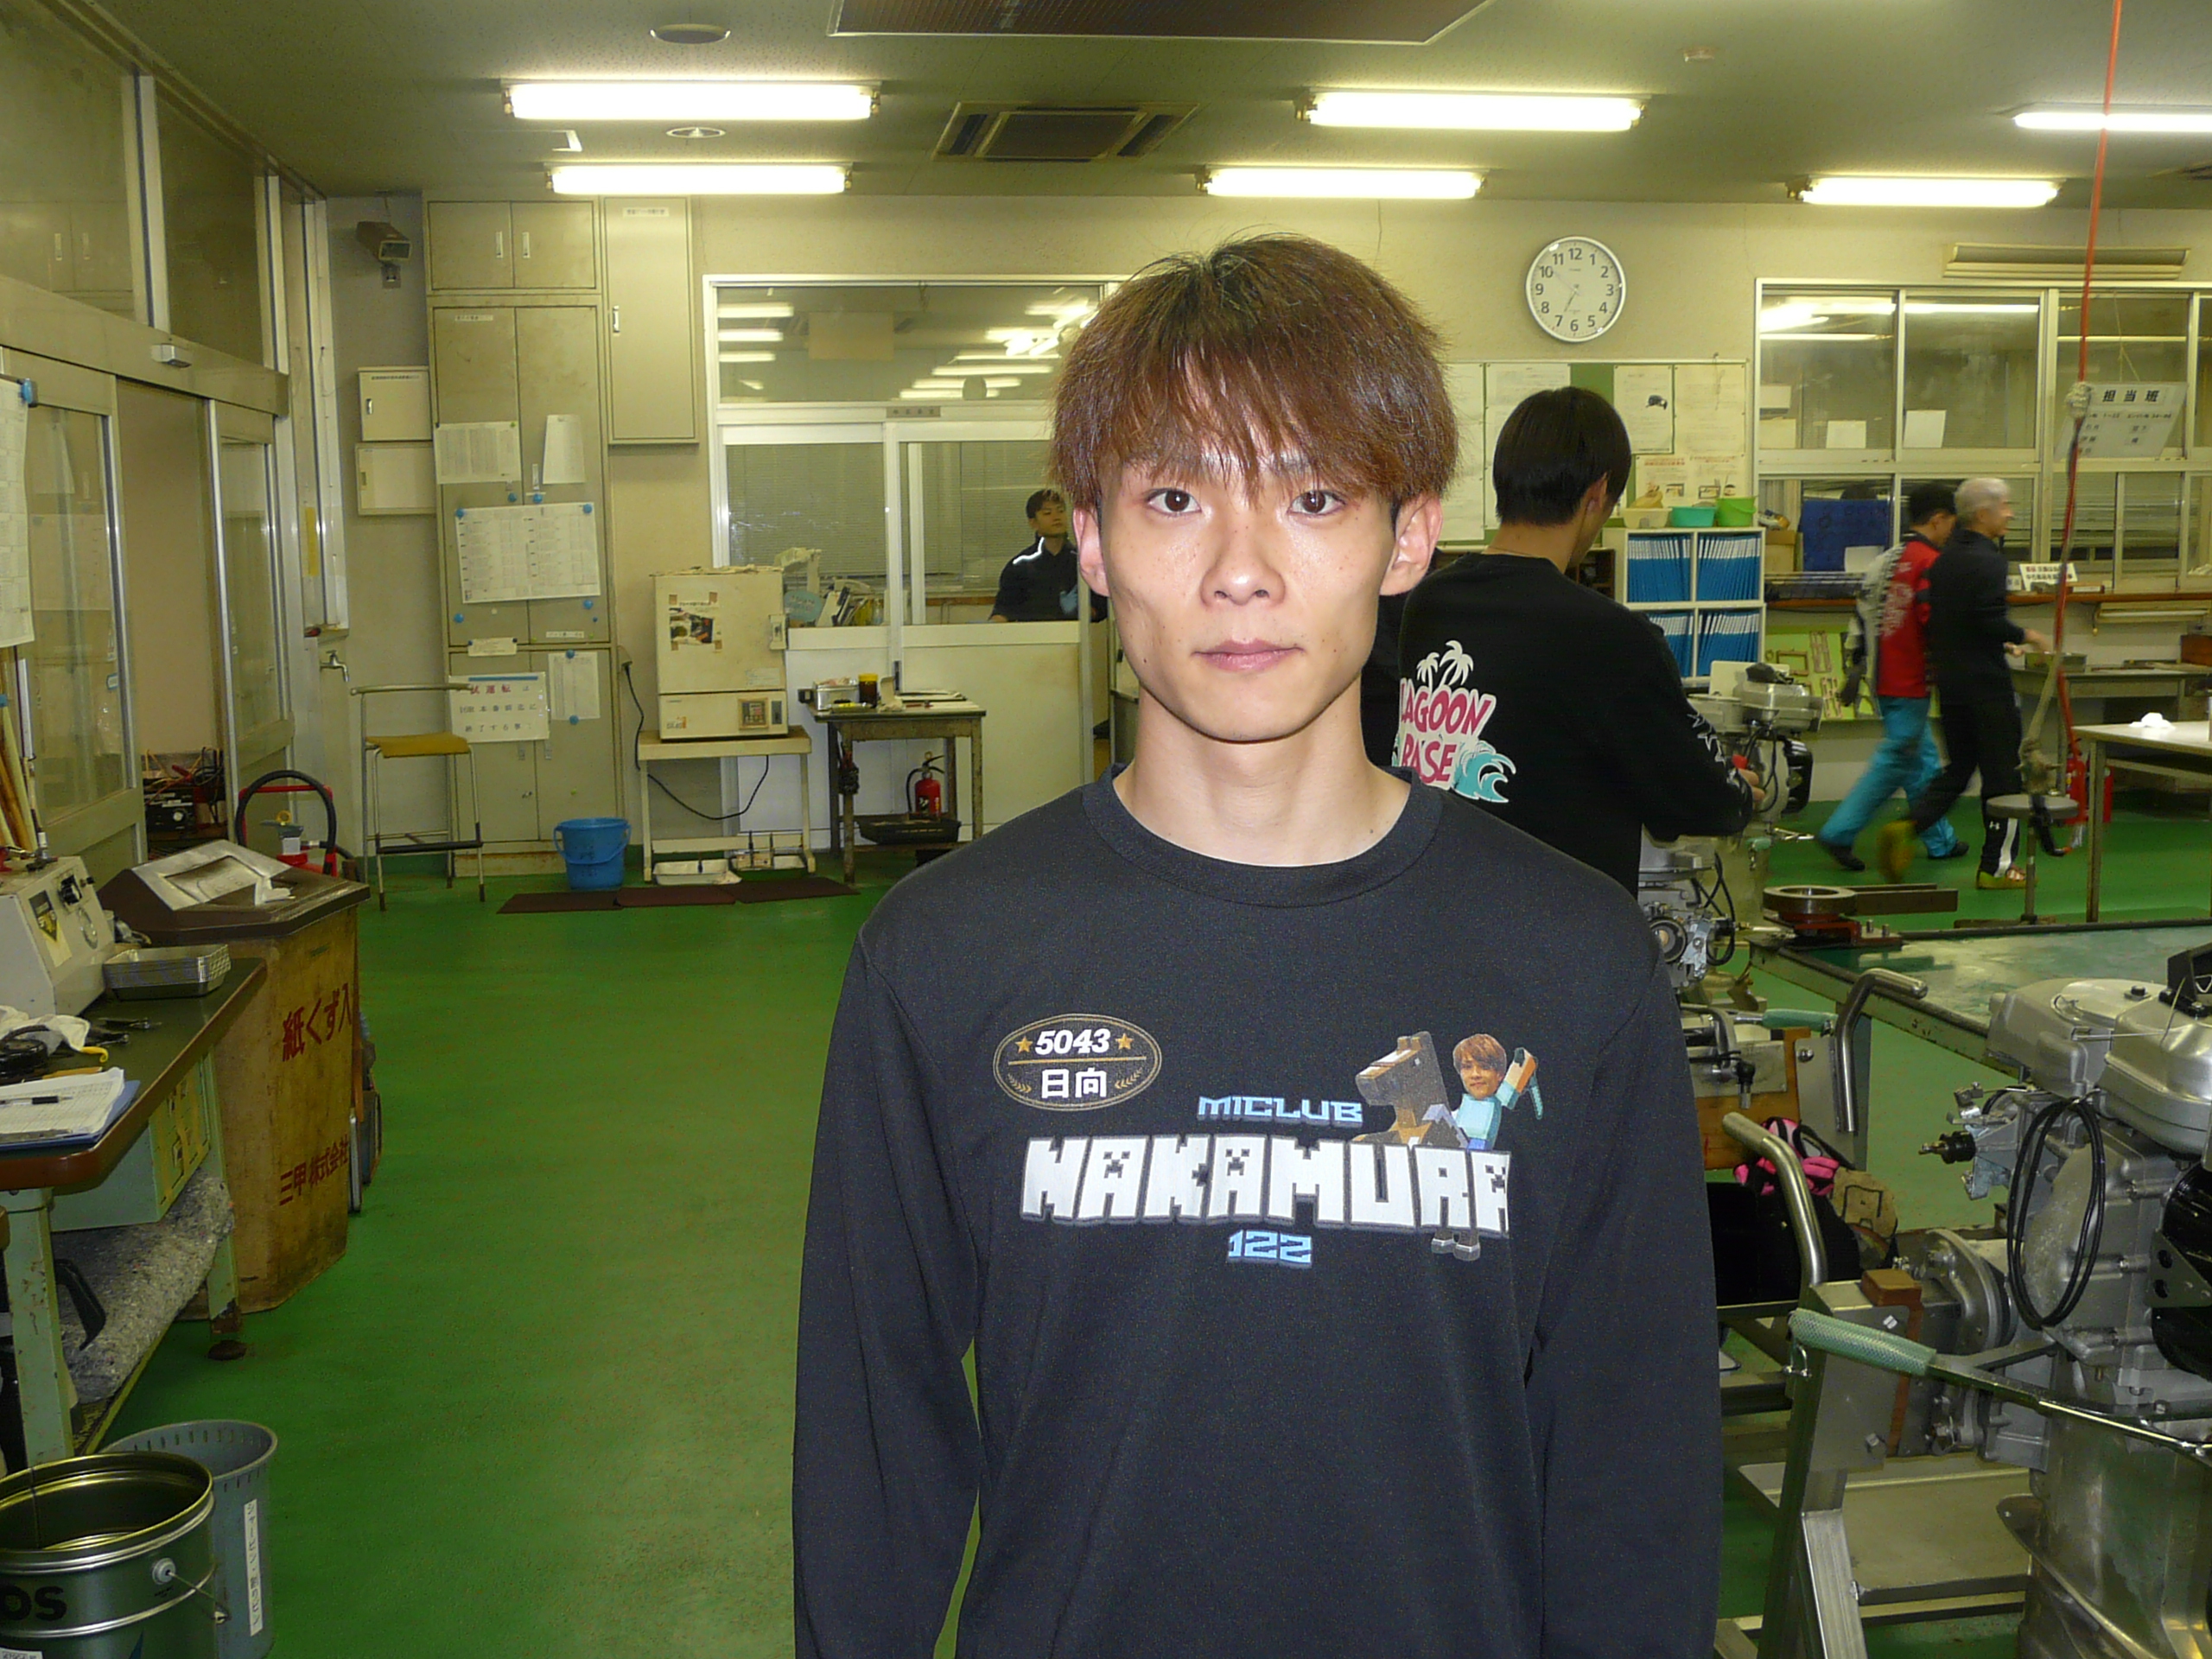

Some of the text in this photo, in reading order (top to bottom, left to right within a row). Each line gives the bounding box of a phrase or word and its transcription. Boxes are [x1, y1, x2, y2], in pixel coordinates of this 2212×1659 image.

[1553, 253, 1564, 265] 11
[1568, 247, 1582, 260] 12
[1590, 253, 1596, 265] 1
[1540, 265, 1554, 278] 10
[1600, 265, 1609, 278] 2
[1535, 283, 1544, 296] 9
[1605, 283, 1614, 296] 3
[1541, 301, 1549, 314] 8
[1599, 302, 1608, 314] 4
[1554, 315, 1563, 327] 7
[1570, 319, 1579, 332] 6
[1587, 315, 1596, 327] 5
[2102, 390, 2159, 403] 担当班
[1401, 680, 1492, 735] LAGOON
[1035, 1028, 1111, 1055] 5043
[1040, 1068, 1108, 1099] 日向
[1198, 1096, 1363, 1128] MICLUB
[1227, 1230, 1313, 1268] 122
